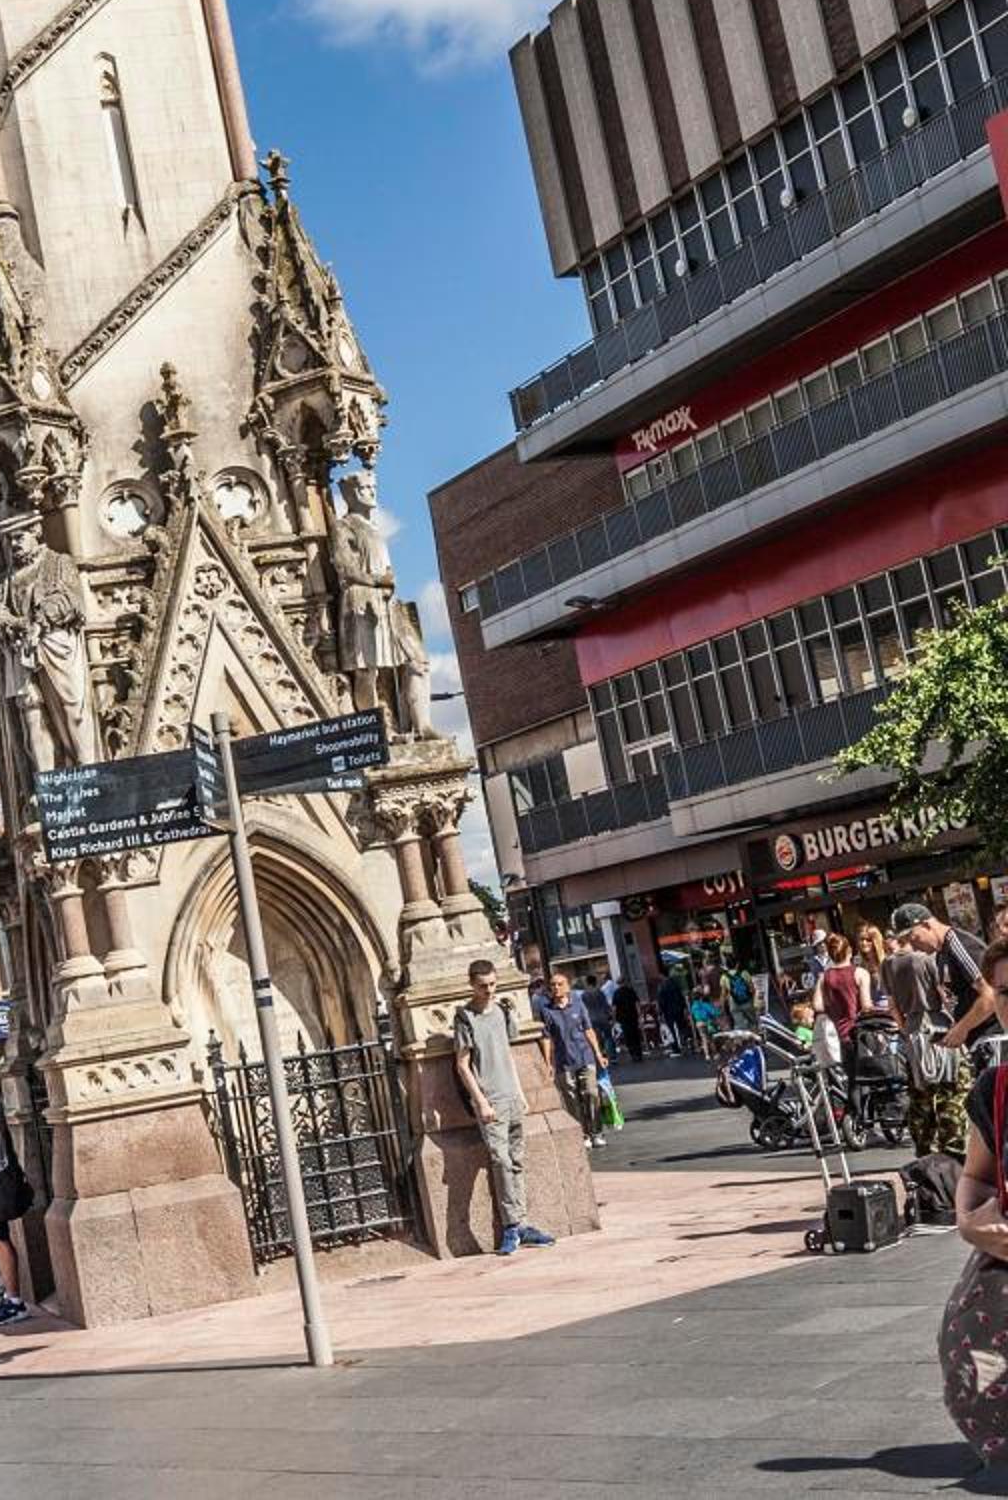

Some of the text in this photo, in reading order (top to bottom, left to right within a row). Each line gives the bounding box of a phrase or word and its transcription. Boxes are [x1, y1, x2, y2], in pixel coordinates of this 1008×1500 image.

[268, 714, 377, 747] Haymarket bus station
[347, 752, 381, 767] Toilets
[43, 792, 63, 804] The
[45, 806, 87, 824] Market
[47, 825, 87, 841] Castle
[89, 817, 137, 834] Gardens
[139, 814, 149, 826] &
[149, 809, 191, 827] Jubilee
[51, 845, 78, 860] King
[79, 836, 123, 855] Richard
[125, 834, 141, 848] III
[143, 832, 153, 844] &
[803, 814, 899, 861] BURGER
